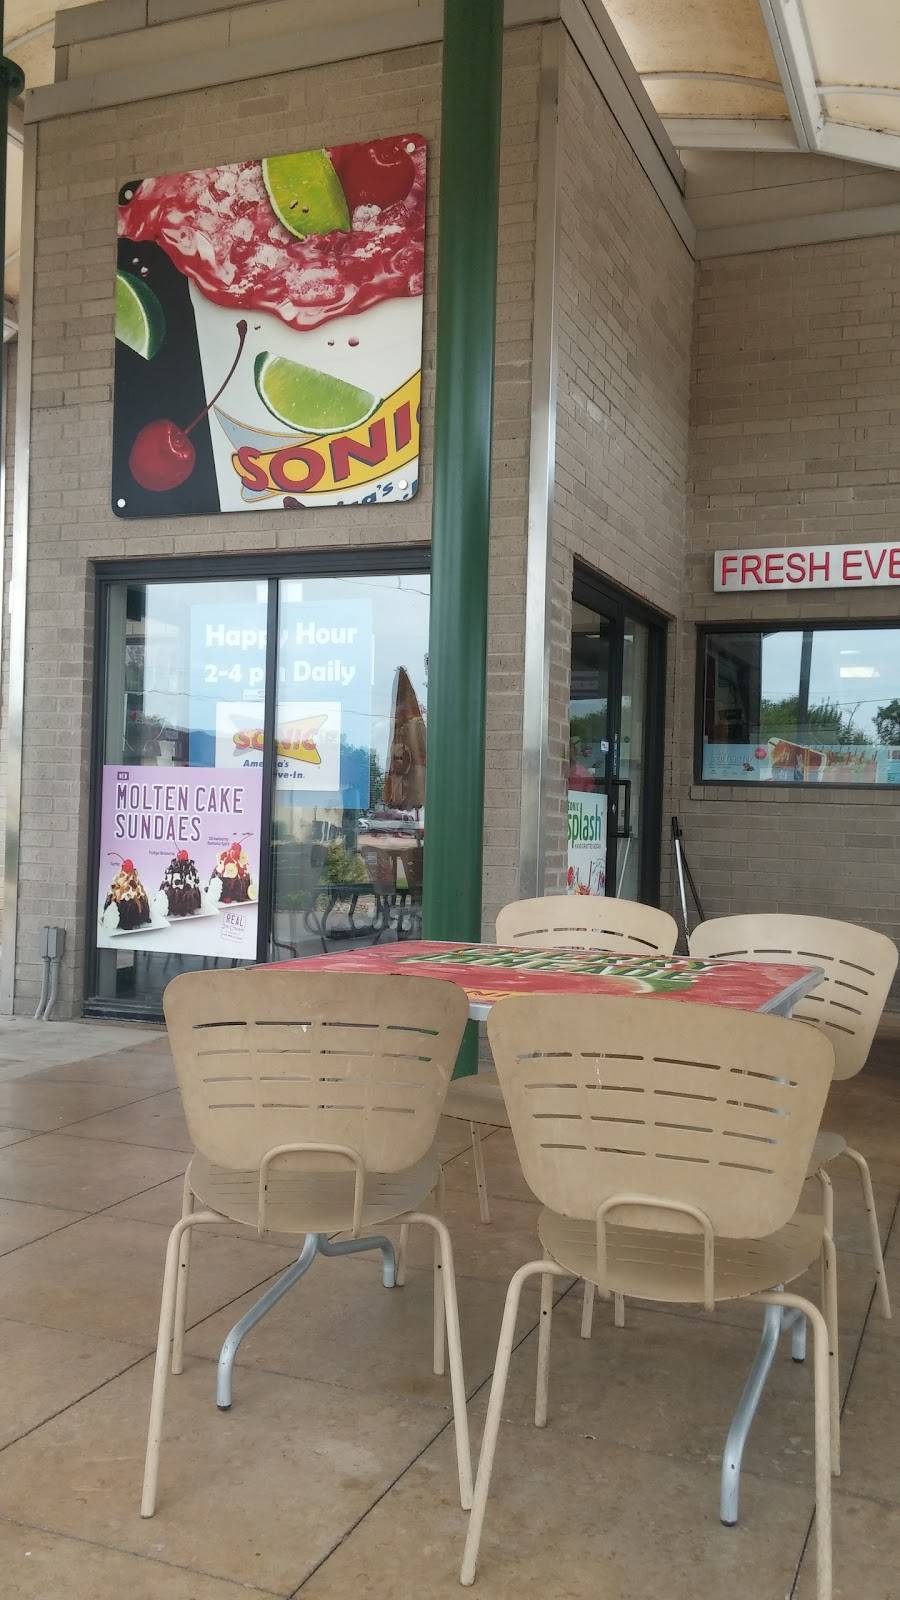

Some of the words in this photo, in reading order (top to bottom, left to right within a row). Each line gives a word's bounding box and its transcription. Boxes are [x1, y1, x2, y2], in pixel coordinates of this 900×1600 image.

[237, 400, 420, 493] SONI
[721, 552, 830, 585] FRESH
[296, 622, 358, 645] Hour
[204, 663, 242, 683] 2-4
[293, 660, 356, 686] Daily
[116, 784, 188, 812] MOLTEN
[195, 787, 244, 813] CAKE
[115, 813, 201, 842] SUNDAES
[226, 913, 243, 927] REAL
